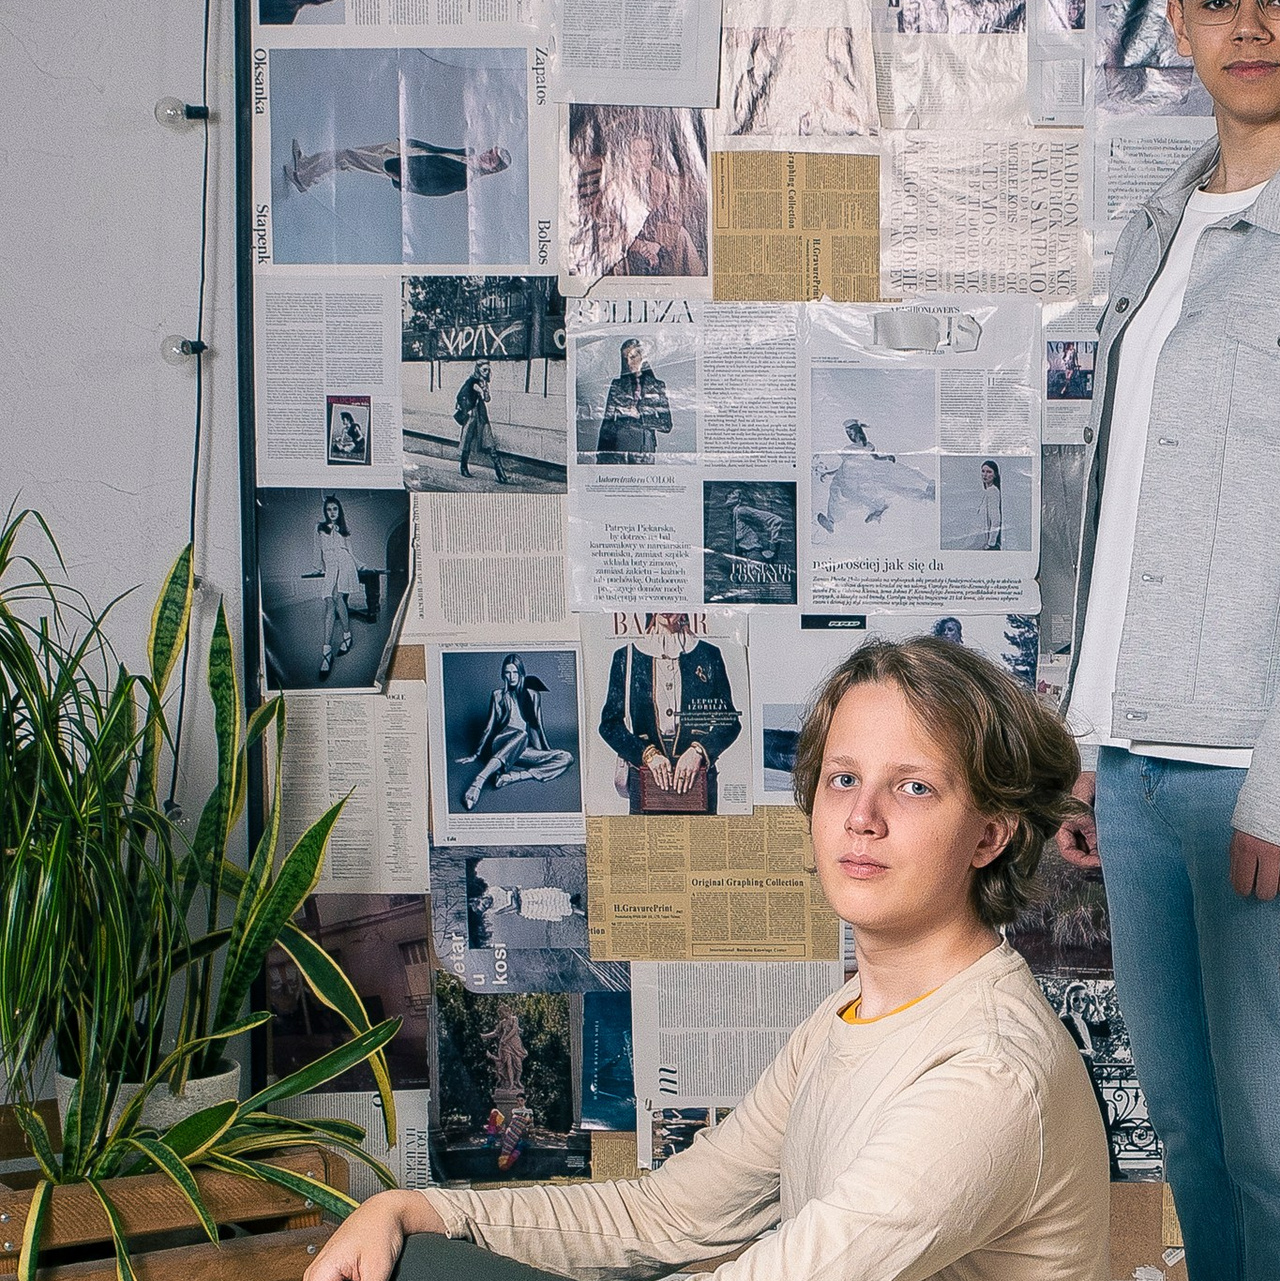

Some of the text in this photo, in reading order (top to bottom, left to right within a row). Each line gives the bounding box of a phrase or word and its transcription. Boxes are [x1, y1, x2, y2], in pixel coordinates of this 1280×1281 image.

[253, 48, 268, 115] Oksanka
[531, 47, 552, 266] Zapatos Bolsos
[982, 142, 998, 247] KATE MOSS
[1048, 142, 1063, 230] HEADRICK
[1064, 142, 1080, 228] MADISON
[788, 189, 797, 228] Collection
[1029, 142, 1047, 293] SARA SAMPAIO
[812, 238, 821, 300] H.GravurePrint
[902, 225, 918, 293] ROBBIE
[895, 306, 960, 314] HIONLOVER'S
[1047, 341, 1093, 354] VOUE
[604, 523, 636, 536] Patrycja
[595, 567, 624, 575] zamiast
[630, 559, 648, 568] buty
[634, 550, 662, 558] zamiast
[882, 558, 904, 573] jak
[907, 559, 925, 573] się
[928, 558, 945, 571] da
[691, 877, 805, 889] Original Graphing Collection
[613, 903, 673, 914] H.GravurePrint
[491, 942, 508, 985] kosi
